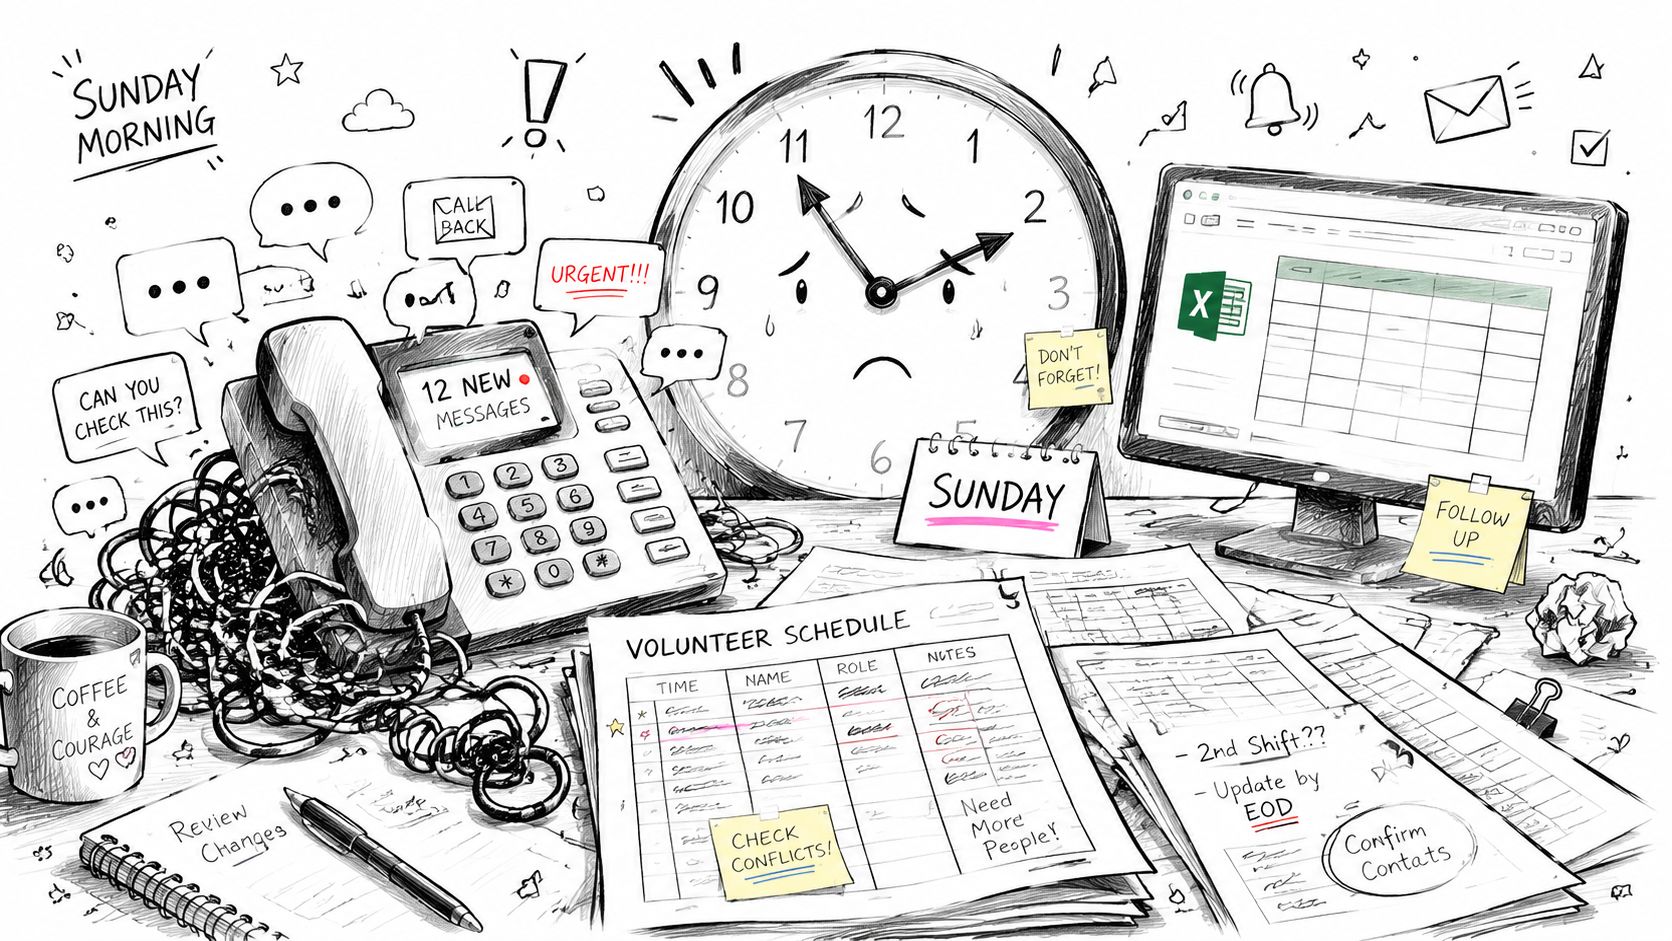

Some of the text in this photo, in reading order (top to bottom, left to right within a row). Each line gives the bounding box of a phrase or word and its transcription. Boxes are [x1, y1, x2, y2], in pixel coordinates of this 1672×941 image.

[73, 63, 201, 120] SUNDAY
[77, 105, 216, 165] MORNING
[864, 104, 904, 139] 12
[780, 128, 808, 164] 11
[967, 128, 978, 164] 1
[434, 195, 485, 215] CALL
[716, 189, 754, 225] 10
[1024, 188, 1047, 224] 2
[441, 218, 489, 236] BACK
[551, 263, 650, 285] URGENT!!!
[697, 274, 720, 310] 9
[1048, 276, 1070, 310] 3
[1038, 345, 1083, 364] DON'T
[422, 368, 511, 404] 12 NEW
[727, 363, 749, 398] 8
[1038, 364, 1100, 387] FORGET!
[79, 376, 160, 411] CAN YOU
[75, 396, 182, 440] CHECK THIS?
[435, 396, 531, 430] MESSAGES
[784, 419, 807, 453] 7
[459, 457, 568, 489] 1 2 3
[871, 440, 892, 474] 6
[472, 488, 582, 524] 4 5 6
[930, 472, 1066, 519] SUNDAY
[1436, 500, 1510, 527] FOLLOW
[485, 521, 595, 557] 7 8 9
[1453, 529, 1480, 548] UP
[548, 564, 560, 579] 0
[626, 628, 773, 660] VOLUNTEER
[784, 609, 911, 645] SCHEDULE
[52, 674, 128, 710] COFFEE
[656, 679, 699, 695] TIME
[745, 670, 793, 687] NAME
[836, 659, 879, 675] ROLE
[87, 708, 101, 728] &
[52, 721, 134, 762] COURAGE
[1196, 738, 1238, 762] 2nd
[1248, 725, 1326, 757] Shift??
[960, 791, 1012, 816] Need
[1213, 777, 1287, 804] Update
[1295, 769, 1319, 791] by
[168, 804, 248, 843] Review
[971, 813, 1024, 839] More
[1243, 797, 1294, 822] EOD
[200, 825, 288, 863] Changes
[731, 825, 800, 850] CHECK
[1344, 824, 1427, 855] Confirm
[731, 840, 832, 873] CONFLICTS!
[1361, 845, 1451, 882] Contats
